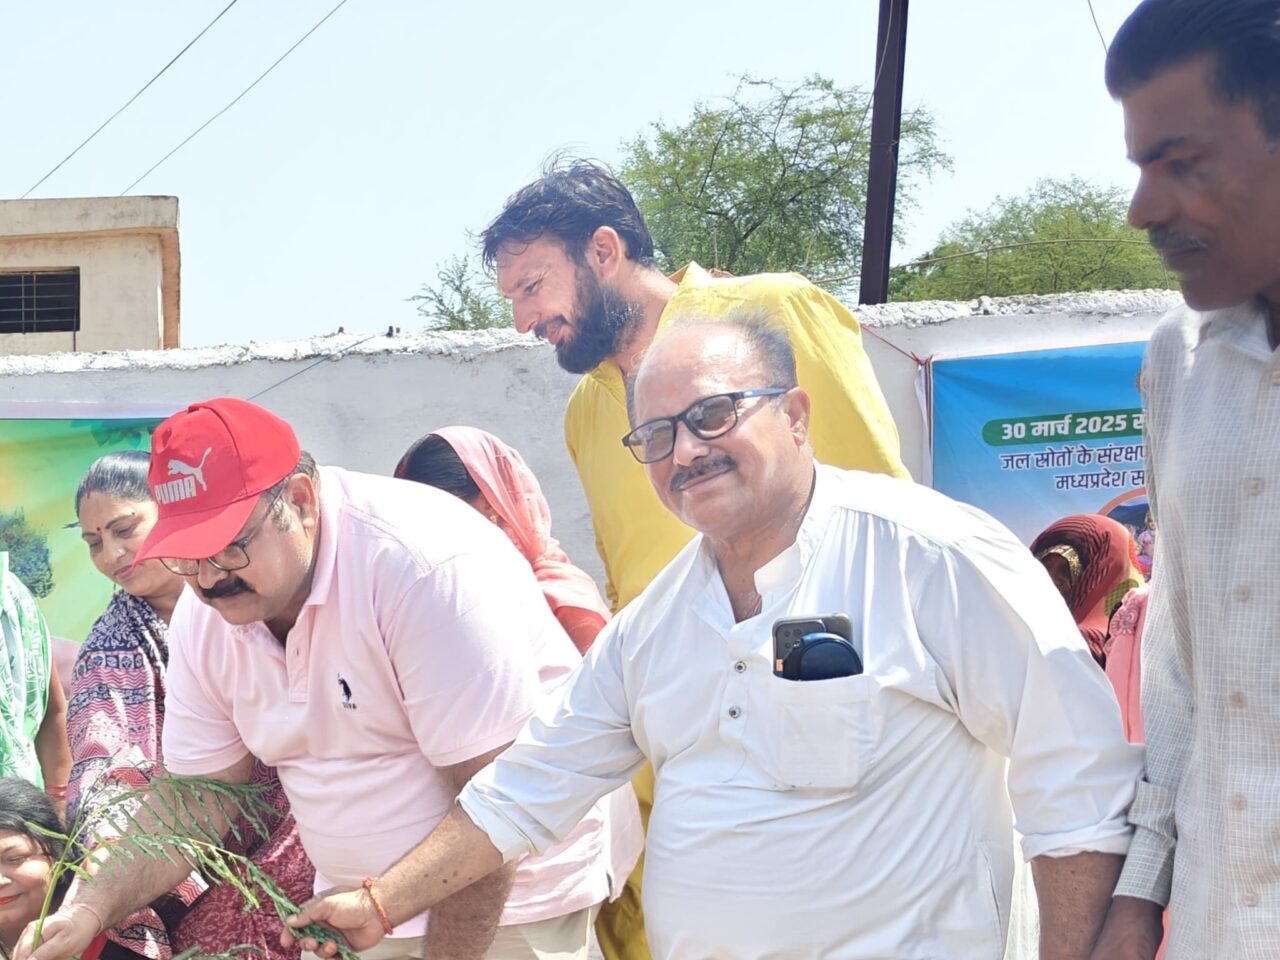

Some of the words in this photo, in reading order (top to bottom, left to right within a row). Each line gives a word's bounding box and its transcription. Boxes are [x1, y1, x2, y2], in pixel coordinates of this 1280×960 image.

[1001, 422, 1027, 440] 30
[1030, 414, 1073, 437] मार्च
[1075, 413, 1128, 434] 2025
[1000, 452, 1032, 469] जल
[1033, 445, 1075, 469] स्रोतों
[1076, 444, 1095, 466] के
[1054, 467, 1128, 490] मध्यप्रदेश
